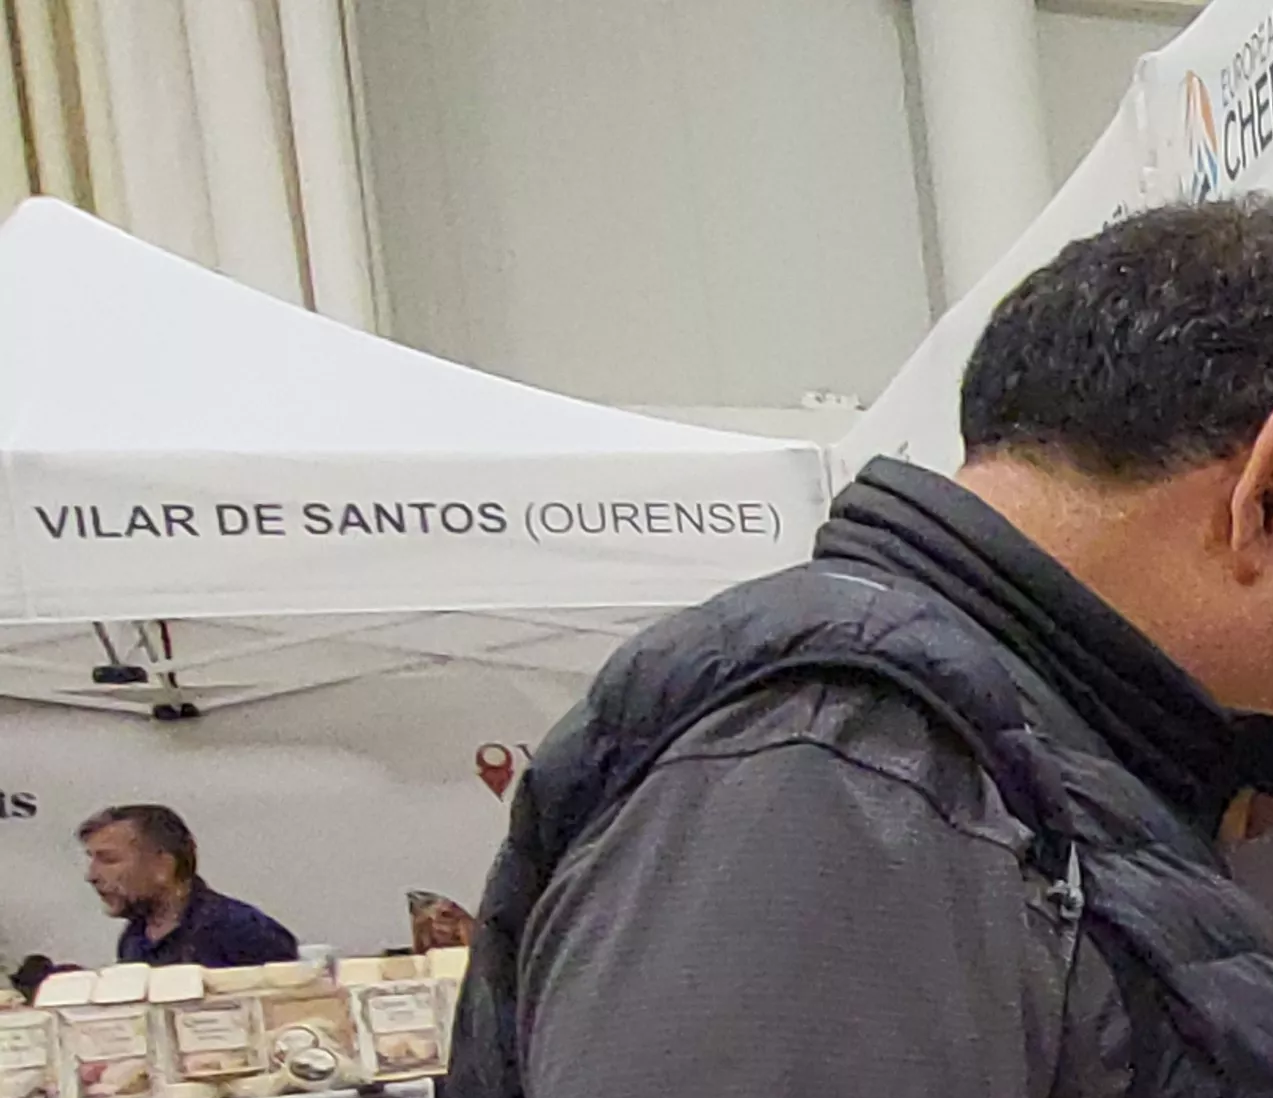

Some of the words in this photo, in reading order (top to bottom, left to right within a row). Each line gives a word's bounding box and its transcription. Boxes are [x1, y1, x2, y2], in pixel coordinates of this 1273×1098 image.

[34, 503, 200, 539] VILAR
[216, 503, 286, 536] DE
[303, 502, 507, 535] SANTOS
[525, 502, 781, 543] (OURENSE)
